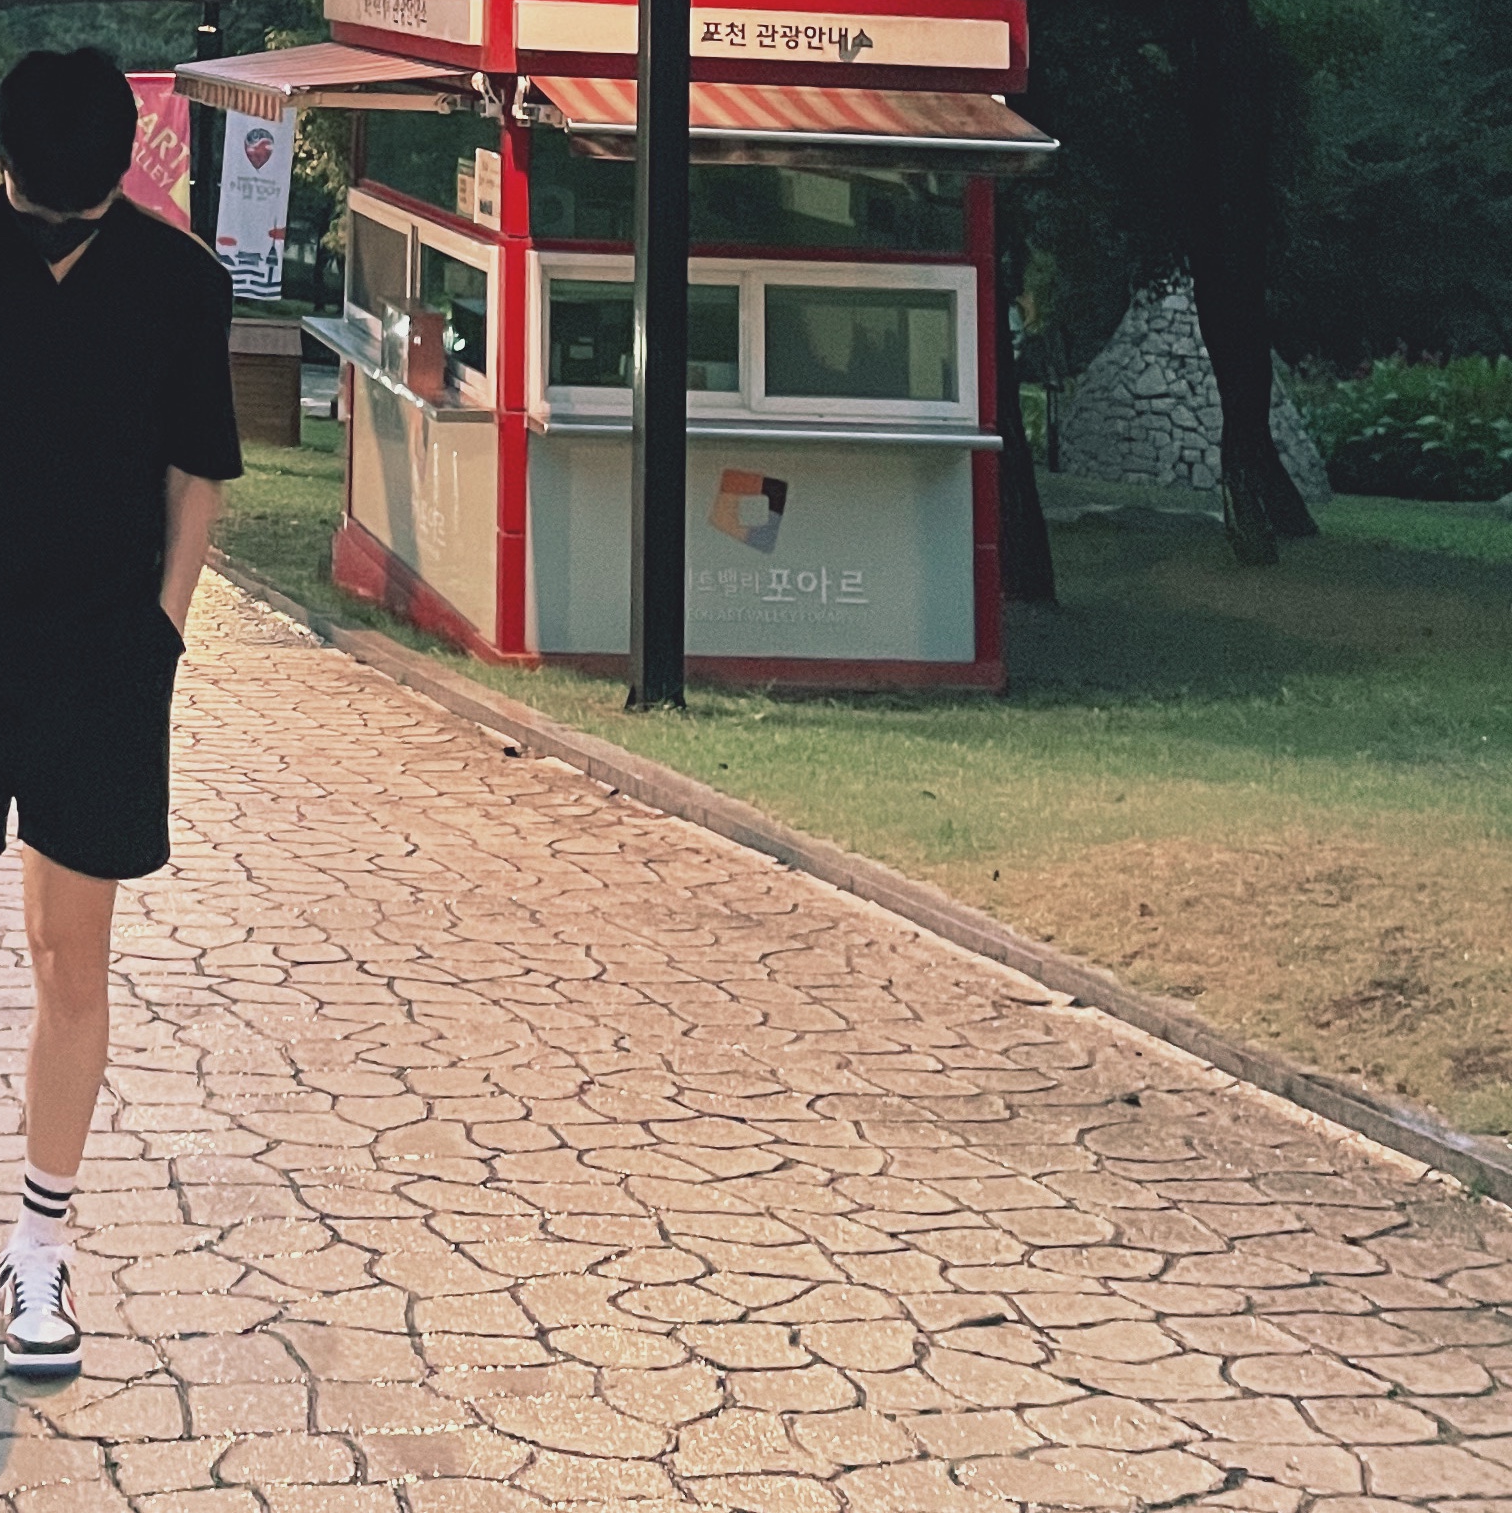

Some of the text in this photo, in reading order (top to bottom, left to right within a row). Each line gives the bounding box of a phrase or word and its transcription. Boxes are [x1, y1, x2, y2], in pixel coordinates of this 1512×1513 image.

[701, 21, 874, 52] 포천 관광안내소
[133, 142, 176, 188] LLEY
[761, 565, 870, 605] 포아르
